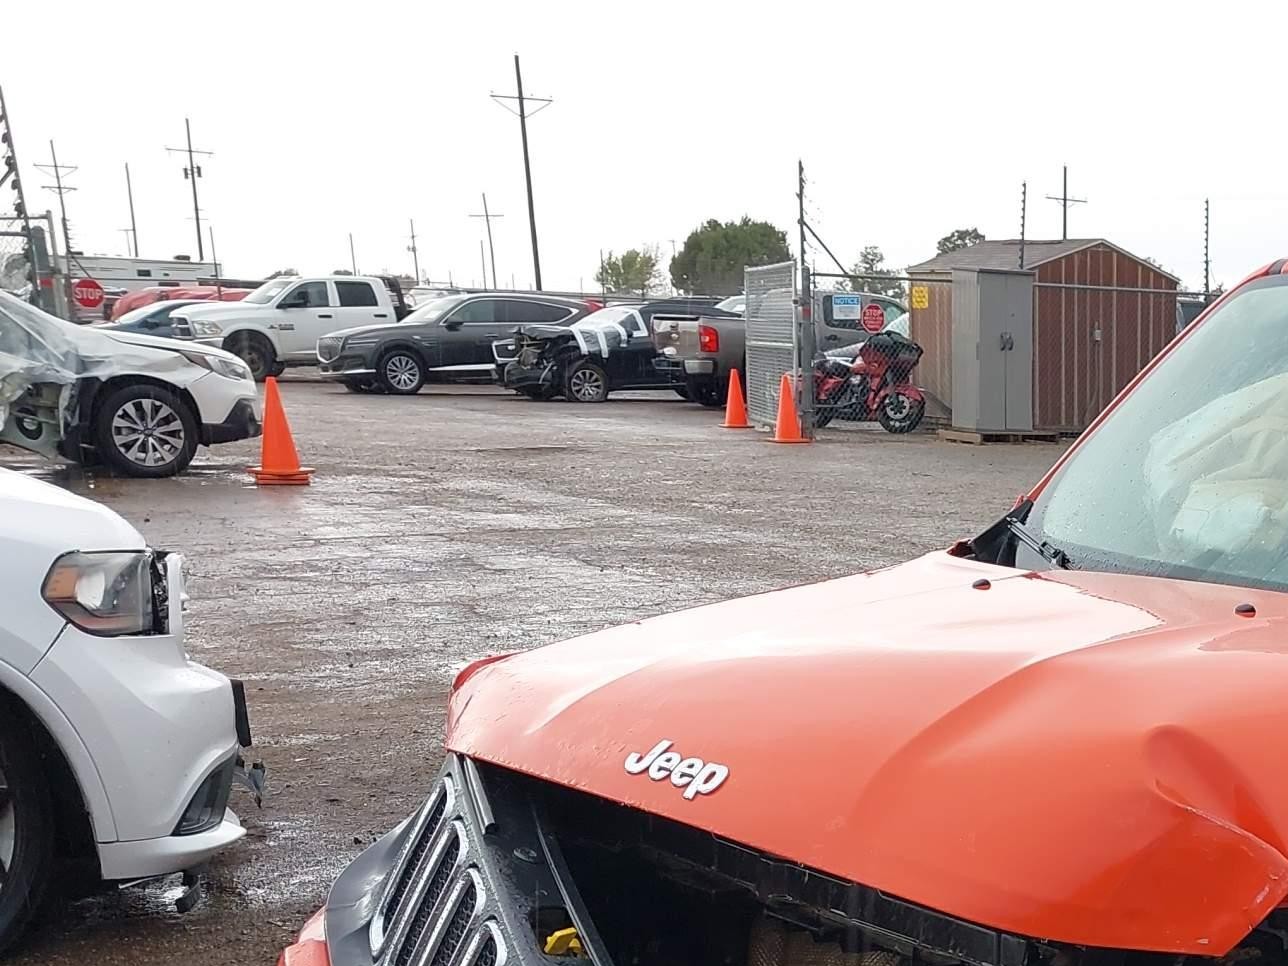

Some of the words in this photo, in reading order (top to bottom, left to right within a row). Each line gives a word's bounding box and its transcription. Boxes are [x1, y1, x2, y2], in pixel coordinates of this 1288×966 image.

[74, 287, 102, 299] STOP
[865, 309, 882, 317] STOP
[624, 739, 730, 800] Jeep
